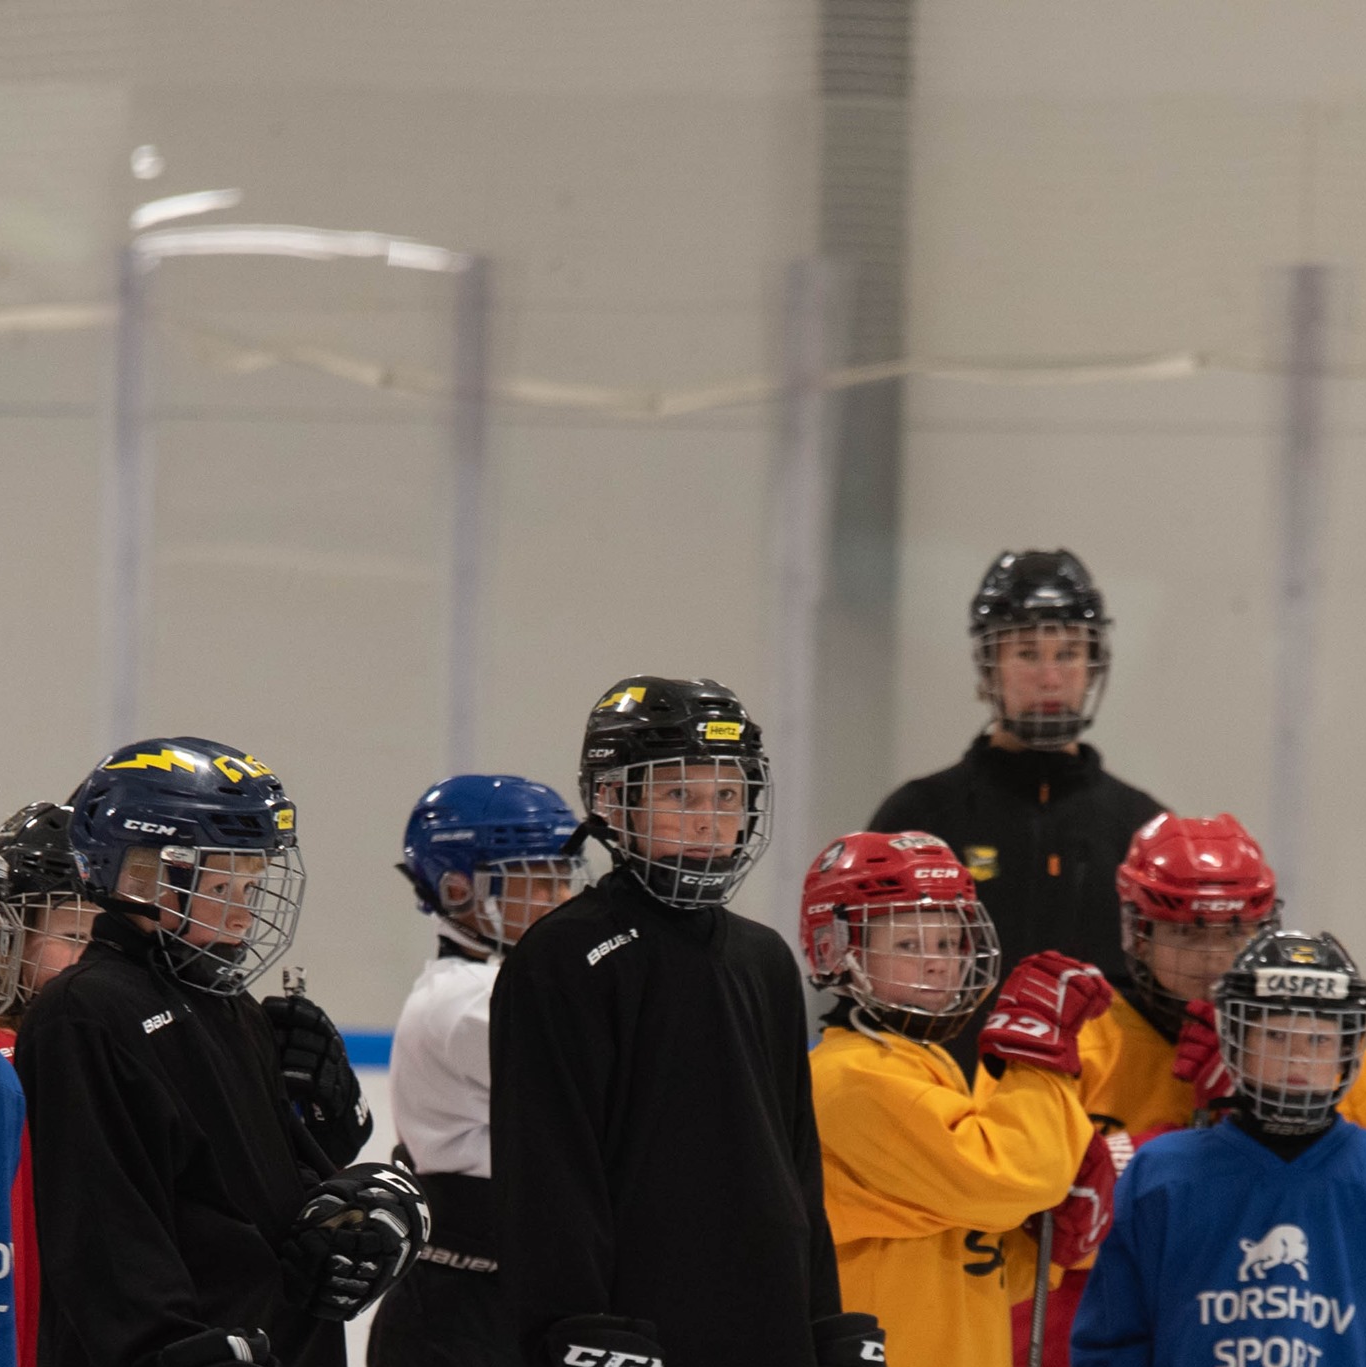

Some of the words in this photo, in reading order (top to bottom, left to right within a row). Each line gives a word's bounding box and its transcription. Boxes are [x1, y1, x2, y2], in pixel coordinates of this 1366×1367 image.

[587, 748, 616, 759] CCM
[123, 818, 178, 837] CCM
[680, 873, 725, 887] CCM
[914, 867, 960, 879] CCM
[1266, 976, 1336, 994] CASPER
[1196, 1285, 1356, 1335] TORSHOV
